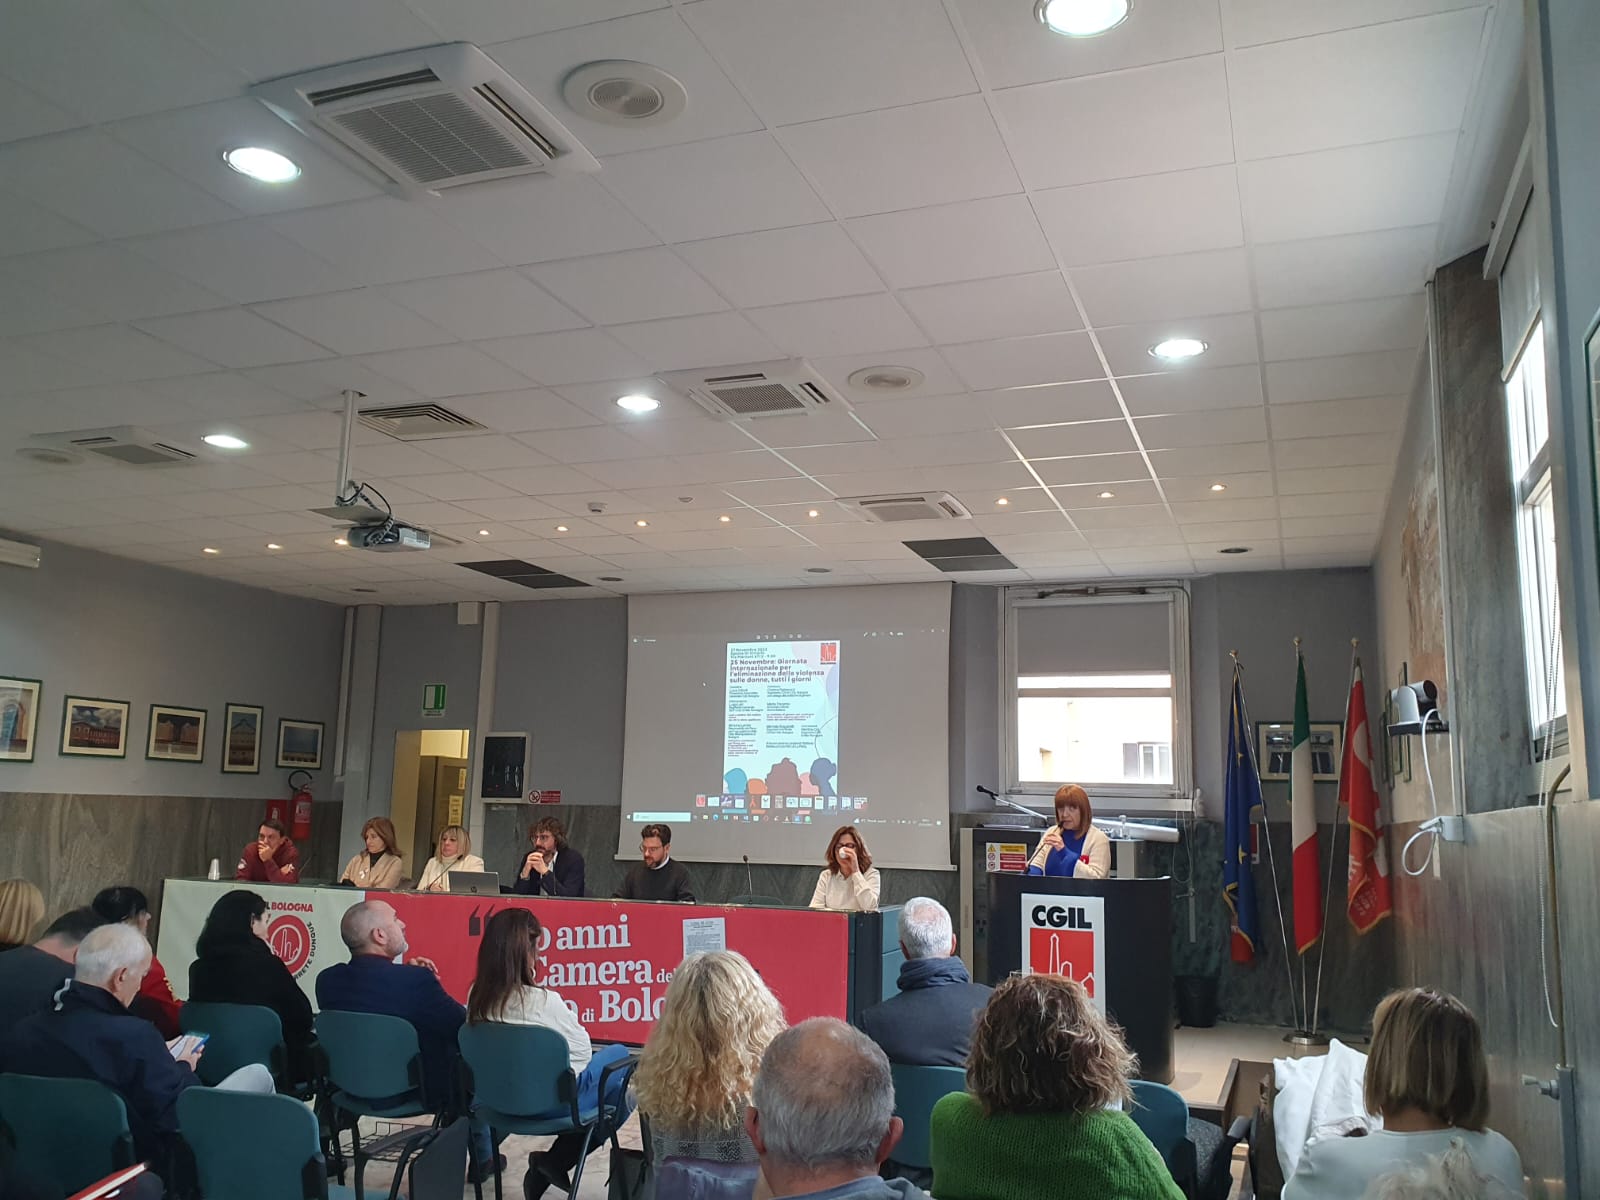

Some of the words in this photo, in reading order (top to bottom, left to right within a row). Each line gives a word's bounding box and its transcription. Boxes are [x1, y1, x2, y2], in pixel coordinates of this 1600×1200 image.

[791, 675, 811, 683] giorni
[272, 902, 314, 912] BOLOGNA
[1032, 904, 1092, 929] CGIL
[556, 913, 631, 950] anni
[294, 958, 312, 979] RRETE
[307, 921, 316, 957] DUNQUE
[534, 955, 653, 987] Camera
[656, 967, 676, 983] de
[582, 1008, 595, 1022] di
[599, 986, 667, 1022] Bolo
